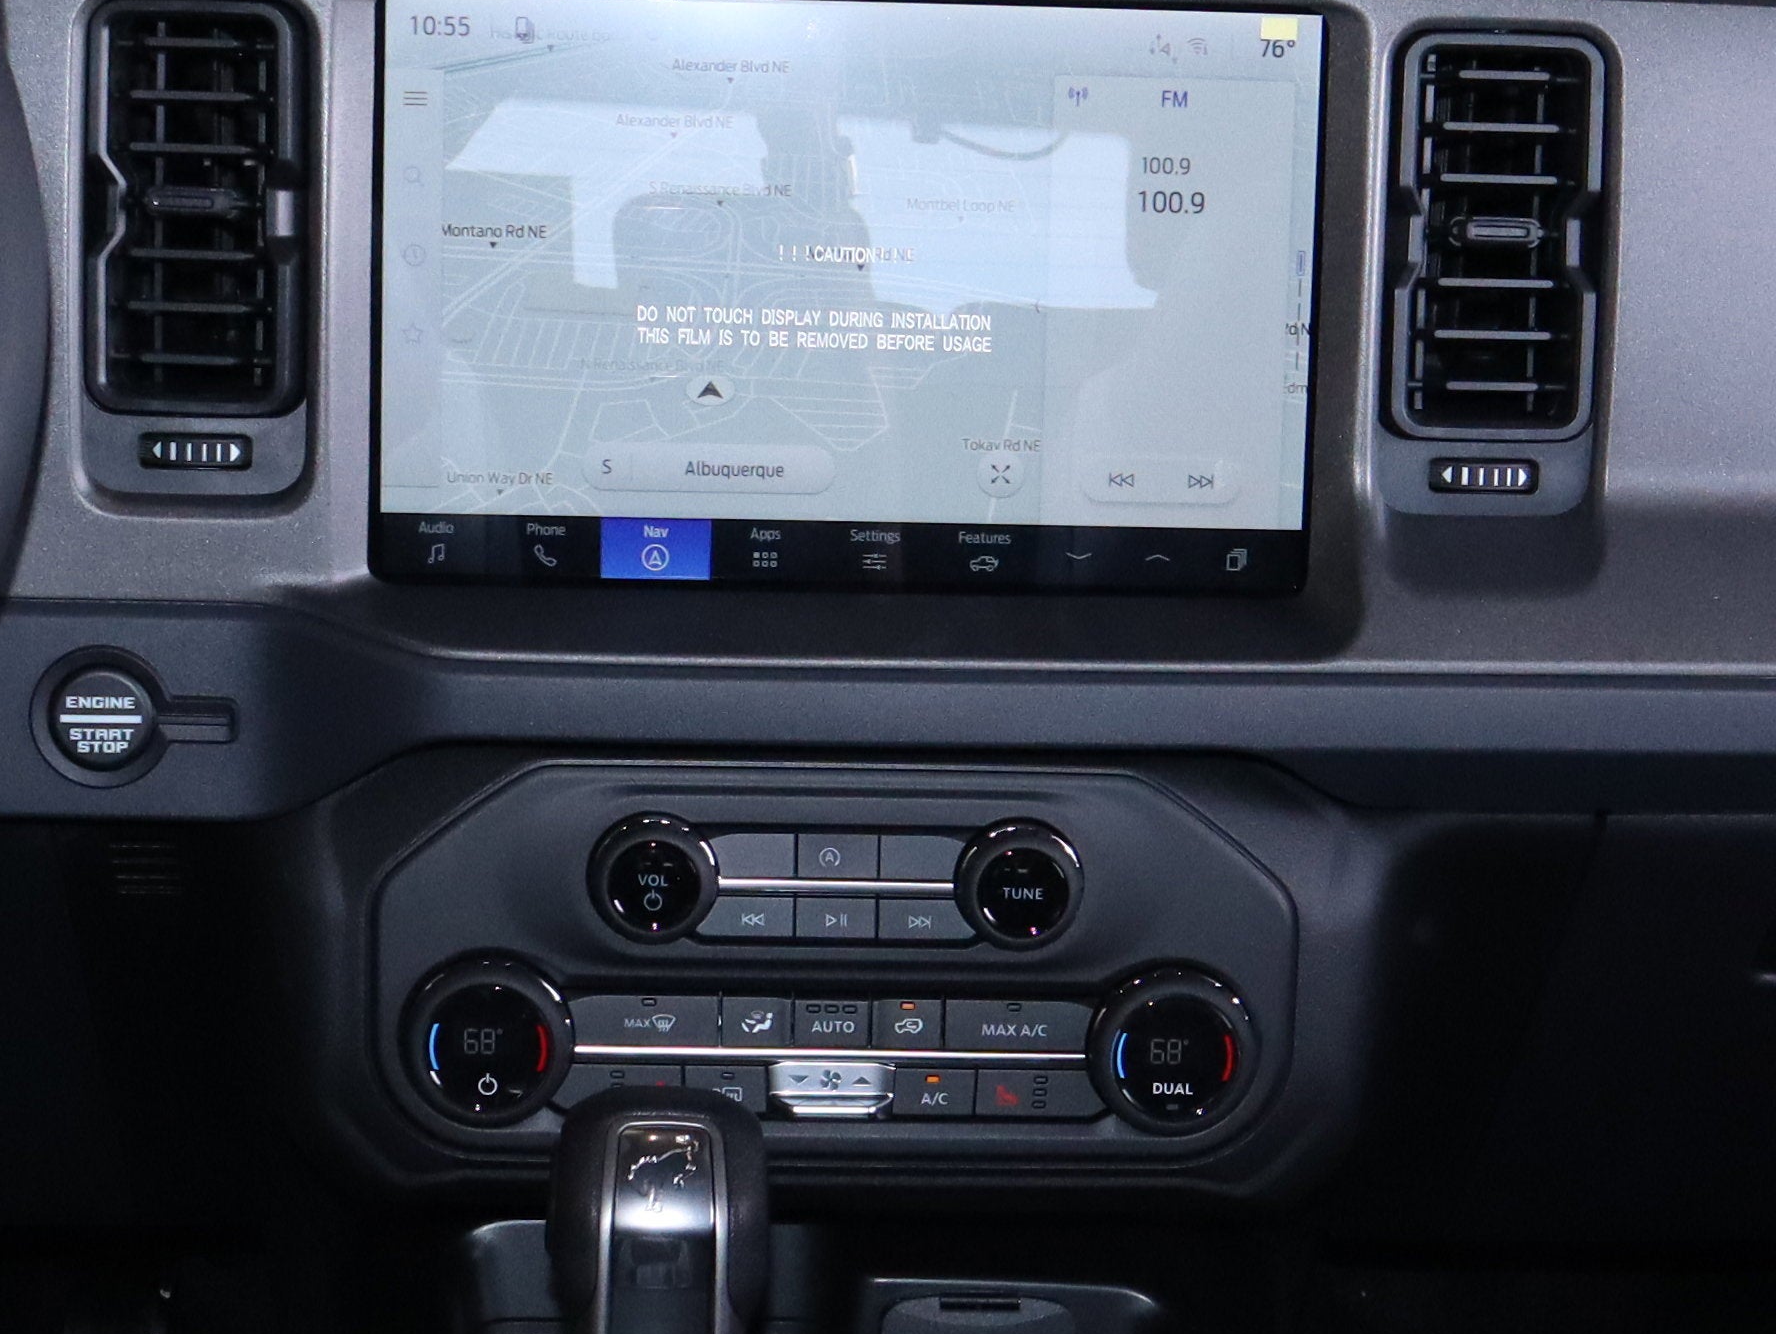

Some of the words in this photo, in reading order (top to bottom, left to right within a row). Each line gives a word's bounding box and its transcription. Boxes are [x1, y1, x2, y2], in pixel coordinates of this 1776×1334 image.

[410, 15, 471, 36] 10:55
[1260, 37, 1296, 58] 76°
[672, 58, 737, 73] Alexander
[740, 59, 770, 73] Blvd
[772, 60, 790, 73] NE
[1161, 90, 1188, 108] FM
[616, 114, 681, 128] Alexander
[684, 115, 713, 128] Blvd
[715, 115, 733, 129] NE
[1142, 157, 1192, 175] 100.9
[648, 182, 658, 194] S
[660, 182, 736, 195] Renaissance
[773, 184, 792, 197] NE
[906, 198, 961, 212] Montbel
[963, 199, 996, 214] Loop
[997, 199, 1016, 212] NE
[1138, 190, 1206, 215] 100.9
[505, 224, 525, 238] Rd
[527, 225, 548, 238] NE
[637, 305, 657, 323] DO
[665, 306, 696, 324] NOT
[703, 307, 753, 325] TOUCH
[761, 308, 821, 326] DISPLAY
[829, 310, 883, 329] DURING
[891, 312, 991, 331] INSTALLATION
[638, 327, 670, 345] THIS
[677, 328, 711, 346] FILM
[718, 329, 733, 346] IS
[741, 330, 761, 347] TO
[768, 330, 790, 348] BE
[797, 331, 868, 350] REMOVED
[877, 334, 935, 352] BEFORE
[942, 336, 992, 354] USAGE
[1003, 439, 1021, 452] Rd
[1023, 439, 1042, 452] NE
[602, 459, 612, 474] S
[685, 460, 784, 480] Albuquerque
[447, 471, 485, 485] Union
[488, 472, 515, 488] Way
[518, 473, 533, 485] Dr
[534, 472, 553, 485] NE
[418, 520, 454, 535] Audio
[526, 522, 566, 537] Phone
[643, 524, 669, 539] Nav
[750, 527, 781, 543] Apps
[850, 529, 901, 545] Settings
[958, 531, 1011, 545] Features
[65, 696, 136, 709] ENGINE
[69, 728, 134, 741] START
[77, 741, 129, 754] STOP
[638, 874, 668, 887] VOL
[1003, 886, 1044, 900] TUNE
[623, 1017, 651, 1029] MAX
[811, 1020, 856, 1034] AUTO
[981, 1023, 1012, 1037] MAX
[1014, 1023, 1048, 1038] A/C
[1152, 1082, 1194, 1097] DUAL
[921, 1092, 949, 1106] A/C
